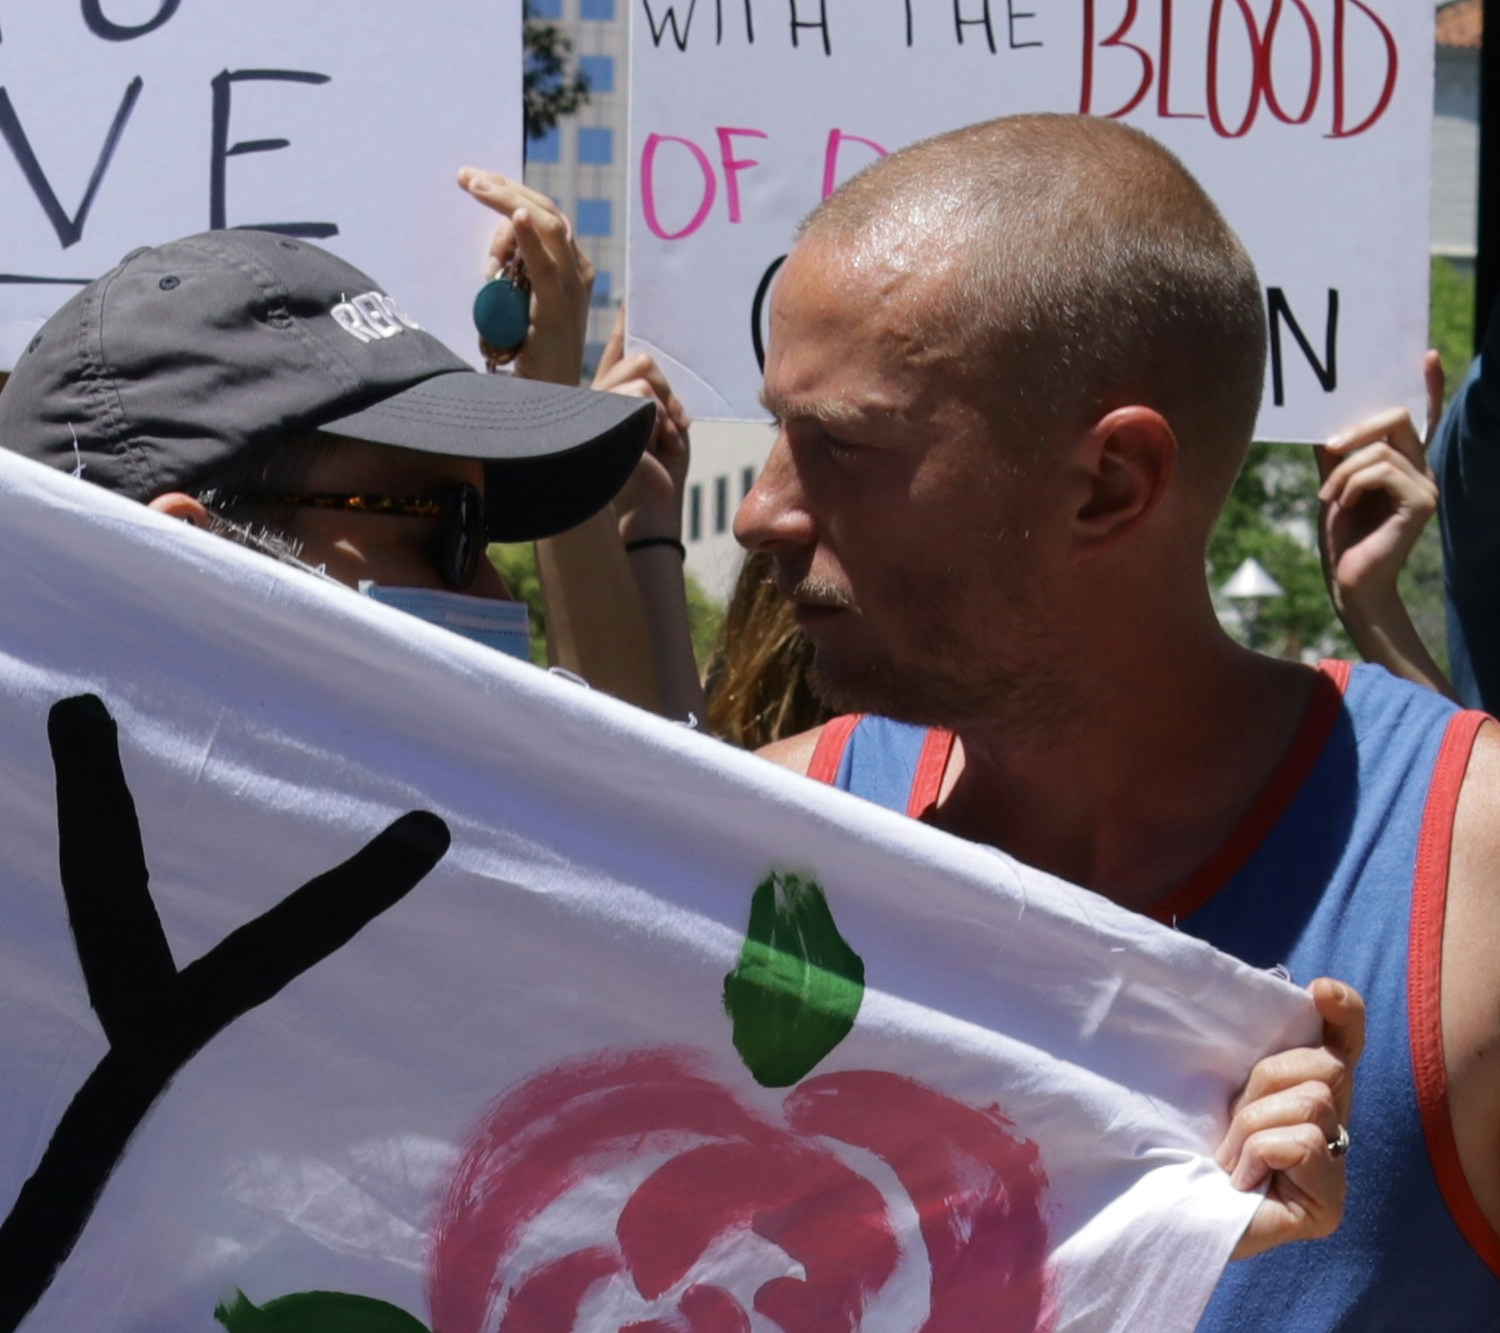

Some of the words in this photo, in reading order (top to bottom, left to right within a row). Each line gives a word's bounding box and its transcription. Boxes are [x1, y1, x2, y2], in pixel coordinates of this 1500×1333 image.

[643, 0, 831, 56] WITH
[904, 0, 1043, 54] THE
[1080, 0, 1399, 139] BLOOD
[640, 126, 769, 241] OF
